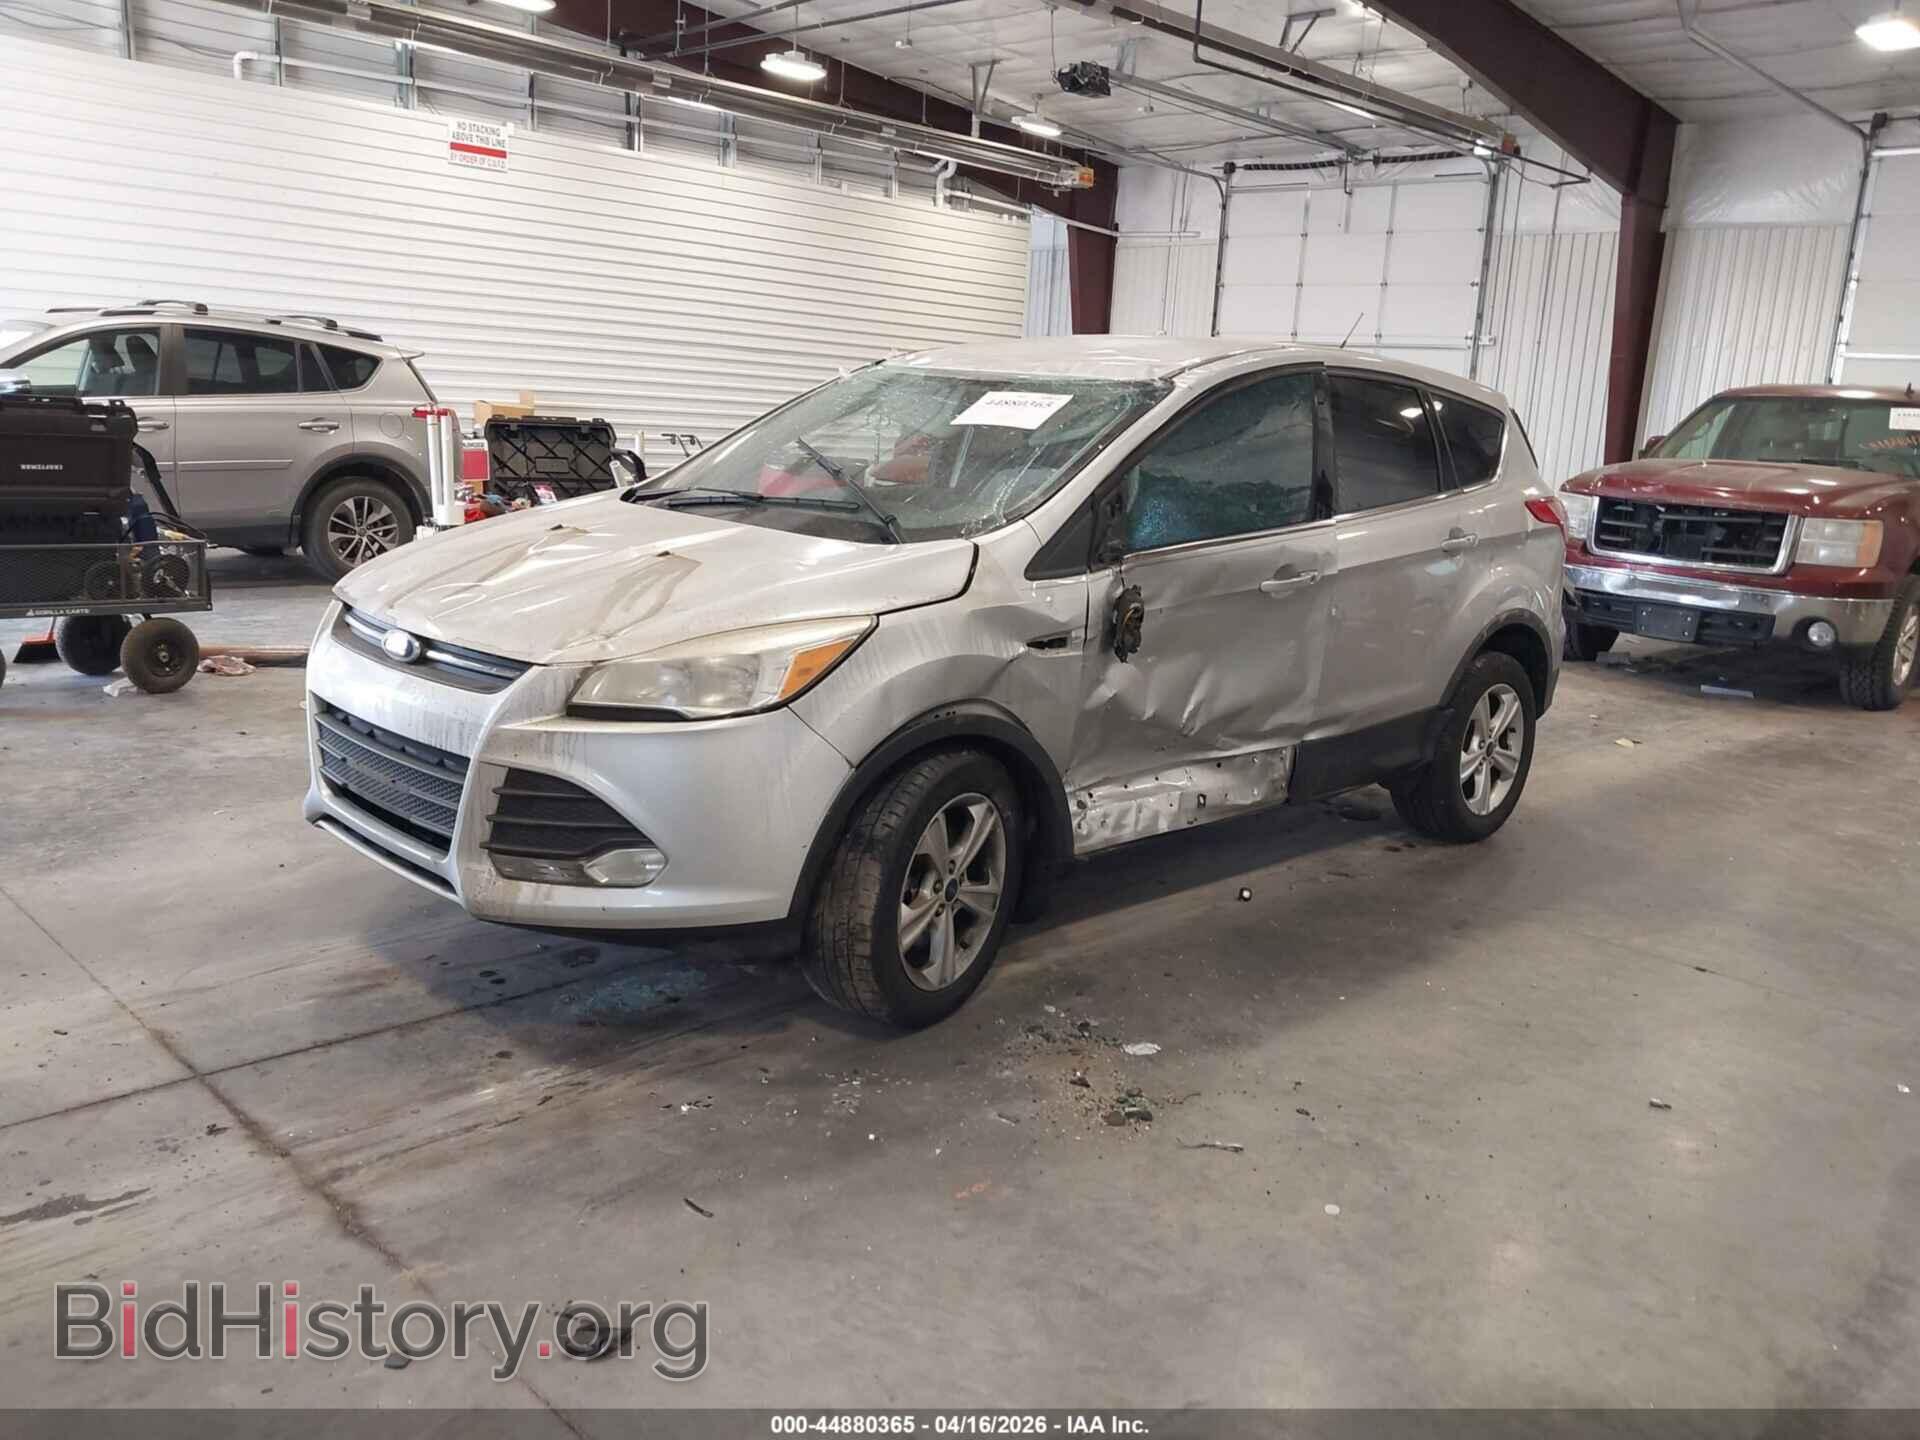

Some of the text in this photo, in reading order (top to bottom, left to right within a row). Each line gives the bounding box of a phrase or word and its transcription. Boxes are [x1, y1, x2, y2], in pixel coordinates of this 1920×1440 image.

[457, 121, 501, 137] NO STACKING
[452, 131, 506, 148] ABOVE THIS LINE
[450, 152, 457, 160] BY
[459, 153, 478, 164] ORDER
[479, 157, 486, 165] OF
